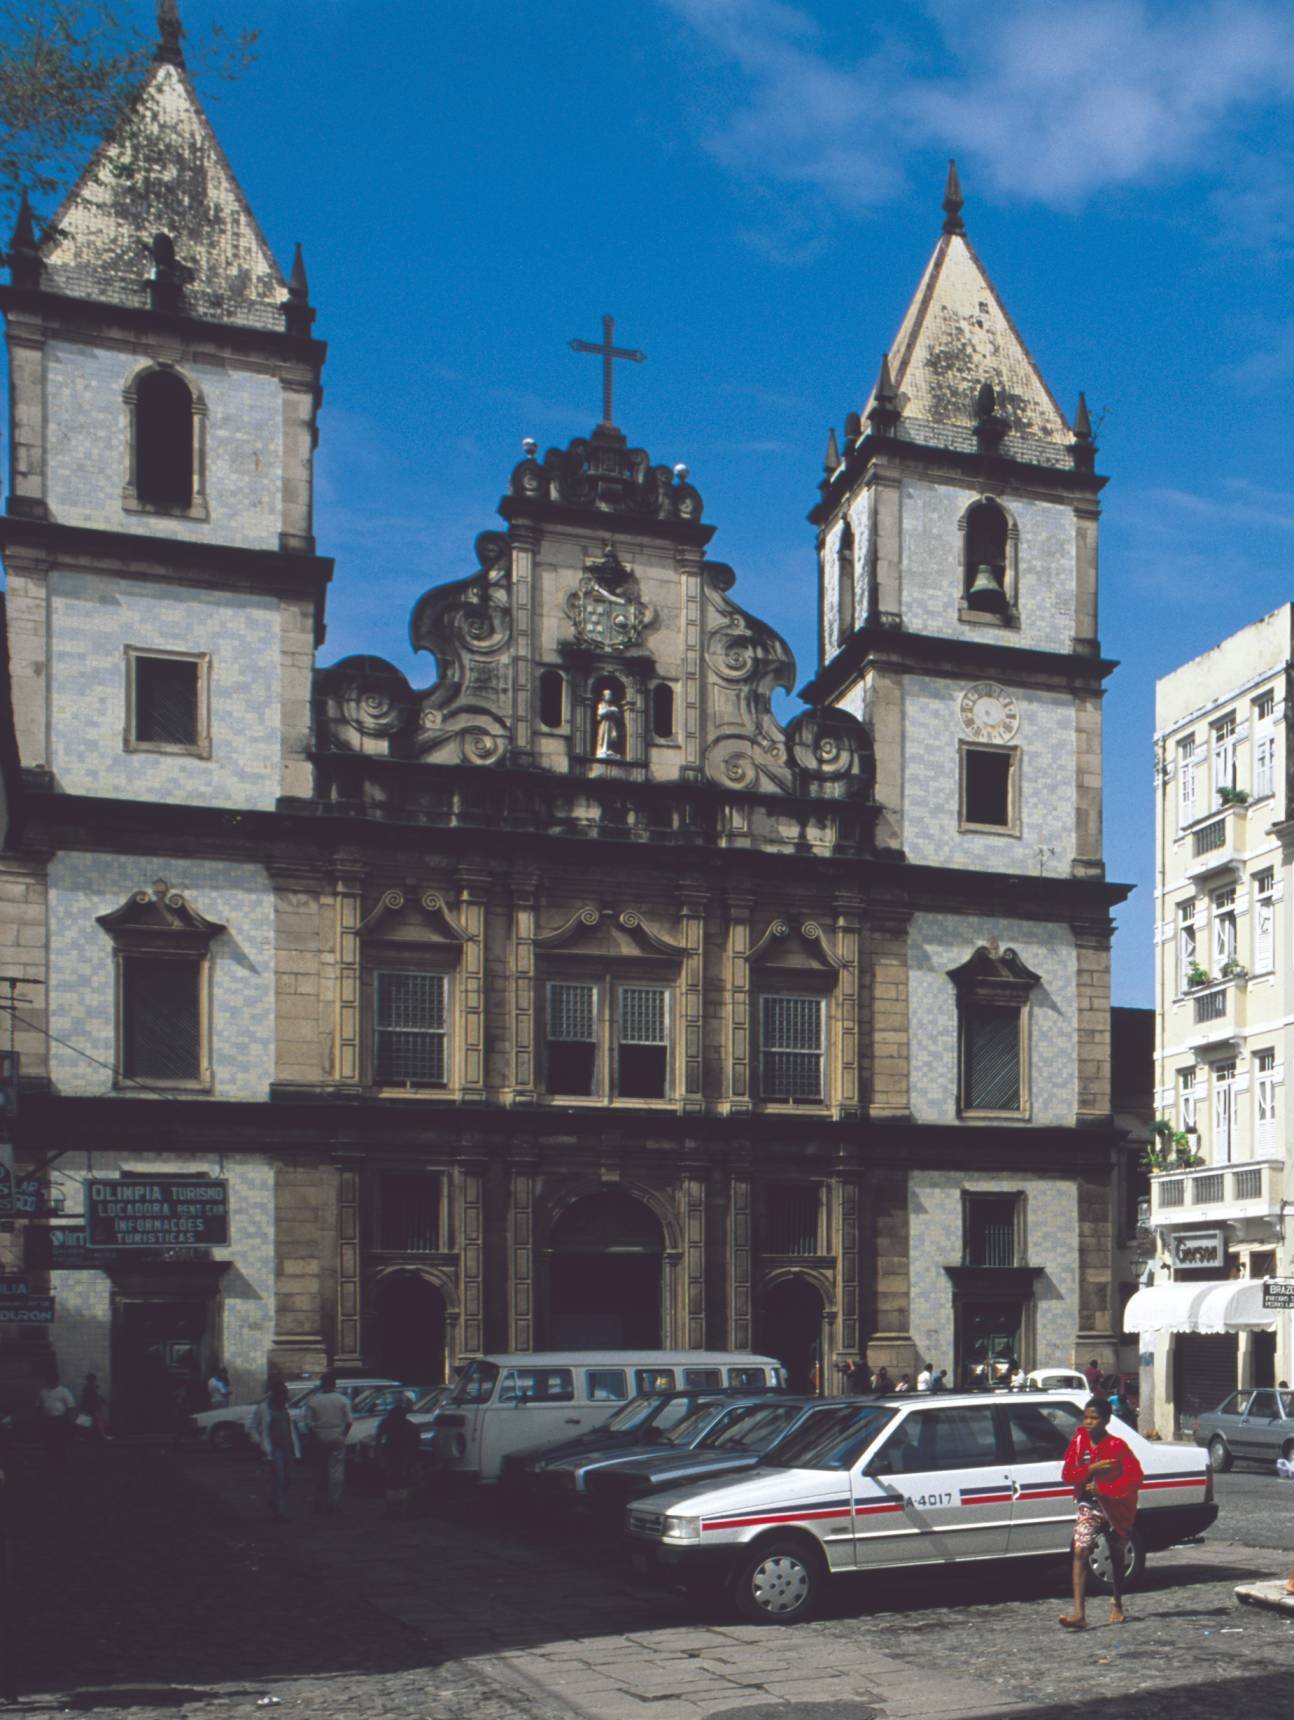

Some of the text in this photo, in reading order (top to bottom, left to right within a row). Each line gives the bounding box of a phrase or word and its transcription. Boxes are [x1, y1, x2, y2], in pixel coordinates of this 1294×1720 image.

[92, 1184, 224, 1200] OLIMPIA TURISMO
[98, 1203, 171, 1216] LOCADORA
